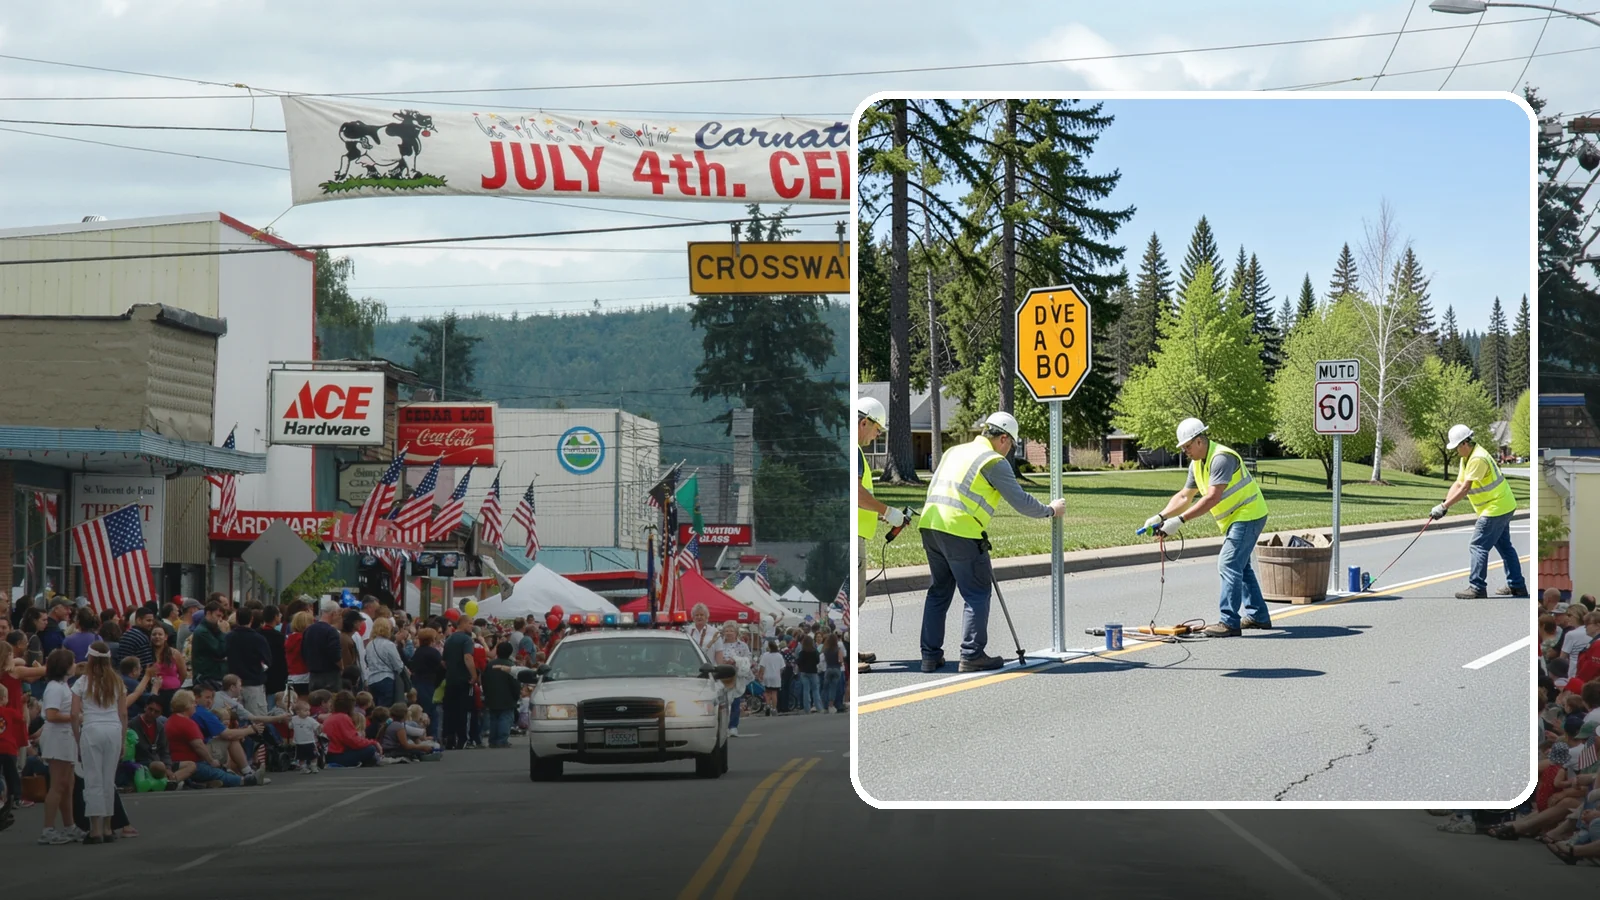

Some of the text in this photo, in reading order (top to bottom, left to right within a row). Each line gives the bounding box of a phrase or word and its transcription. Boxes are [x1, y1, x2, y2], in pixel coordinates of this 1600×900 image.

[481, 141, 605, 192] JULY
[632, 150, 746, 198] 4th.
[697, 254, 850, 280] CROSSWA
[1037, 353, 1070, 379] BO
[282, 380, 373, 420] ACE
[1318, 394, 1354, 421] 60
[406, 409, 485, 422] CEDAR LOG
[283, 421, 370, 436] Hardware
[416, 428, 477, 447] Coca-Cola
[353, 467, 386, 481] Simpl
[96, 485, 125, 495] Vincent
[126, 486, 136, 495] de
[137, 486, 155, 495] Paul
[213, 516, 331, 536] HARDARE
[688, 526, 741, 535] CRNATION
[699, 535, 730, 543] GLASS
